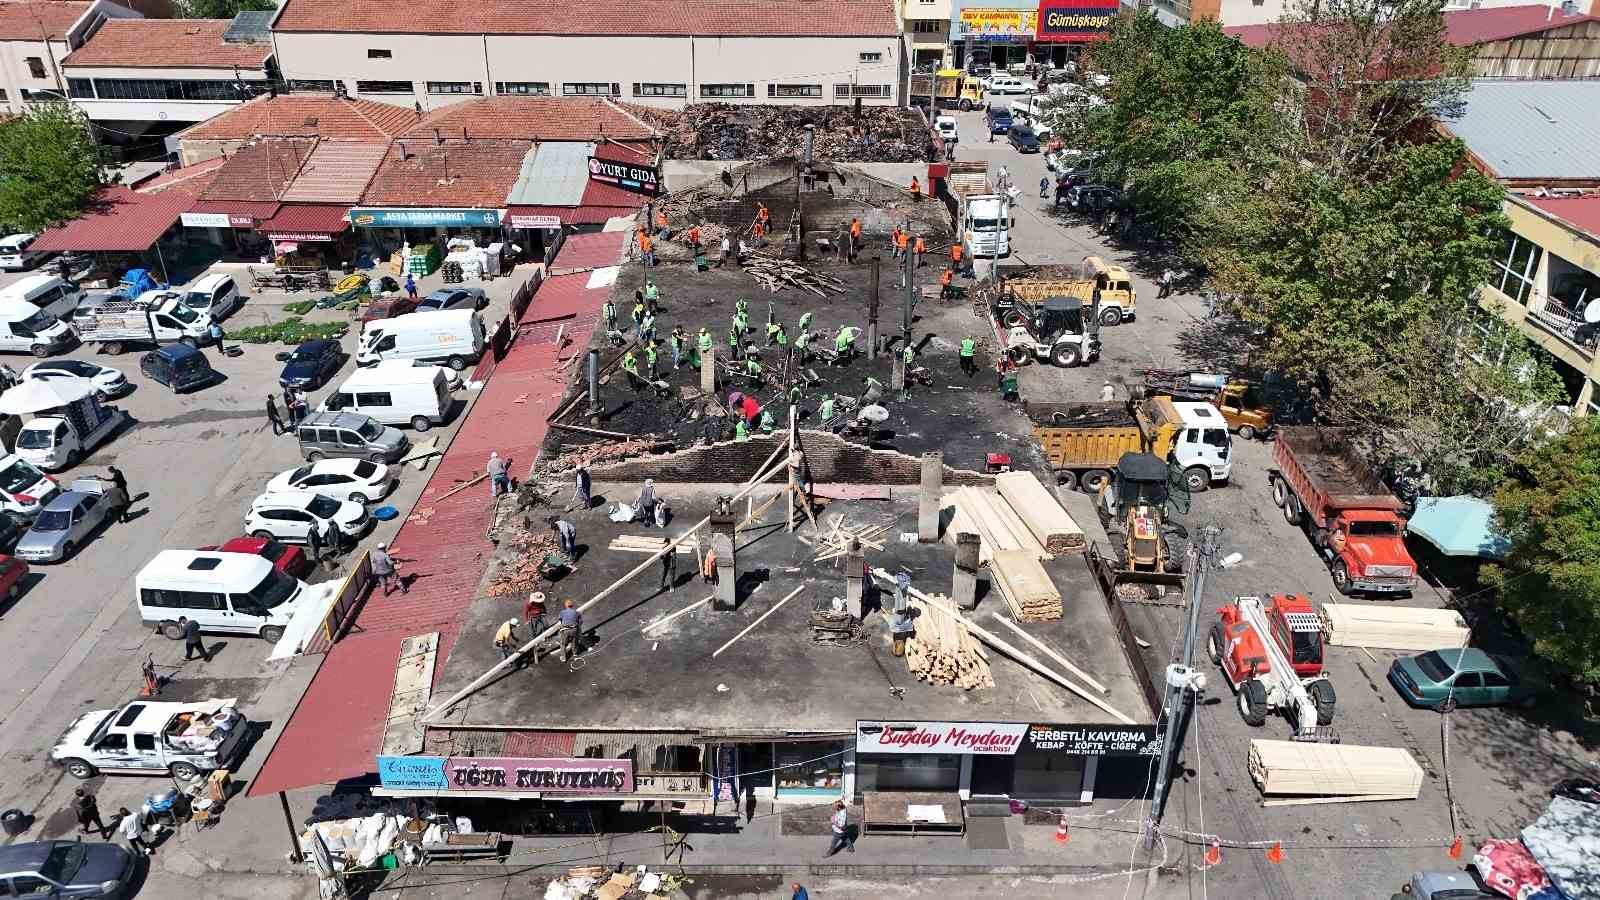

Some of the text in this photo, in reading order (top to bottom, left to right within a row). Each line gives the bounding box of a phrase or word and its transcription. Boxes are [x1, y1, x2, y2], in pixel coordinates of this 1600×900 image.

[1048, 13, 1110, 28] Gümüşkaya
[600, 163, 628, 178] YURT
[630, 169, 657, 184] GIDA
[432, 212, 465, 221] MARKET
[879, 725, 1020, 748] Buğday Meydanı
[1029, 729, 1146, 742] ŞERBETLİ KAVURMA
[1036, 741, 1065, 749] KEBAP
[1074, 740, 1104, 750] KÖFTE
[1110, 741, 1137, 751] CİĞER
[454, 762, 506, 787] UĞUR
[515, 765, 625, 791] KURUYEMİŞ
